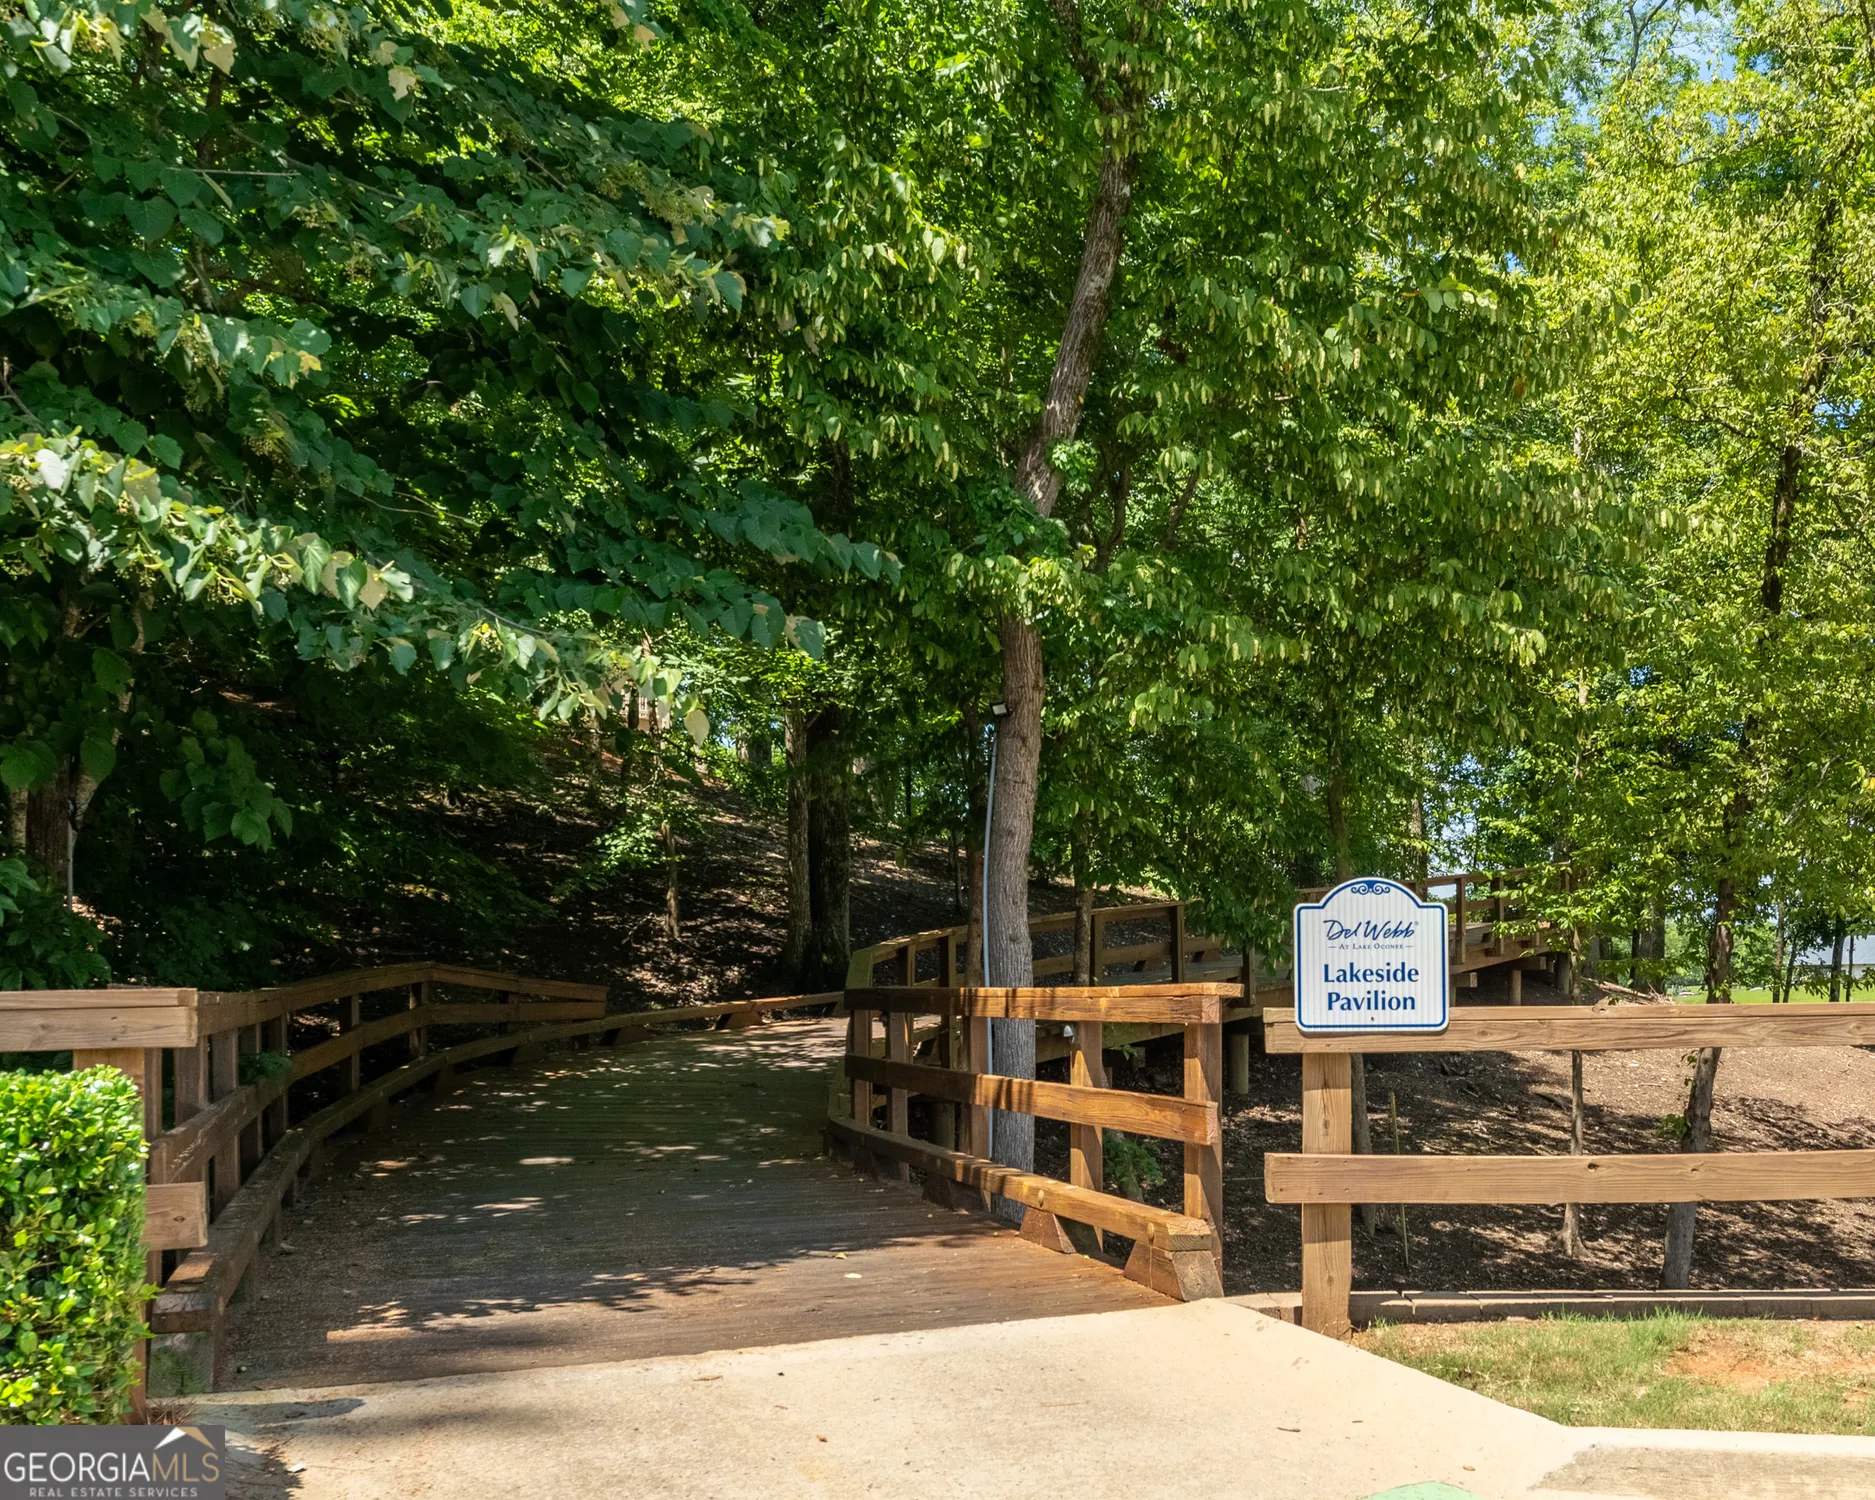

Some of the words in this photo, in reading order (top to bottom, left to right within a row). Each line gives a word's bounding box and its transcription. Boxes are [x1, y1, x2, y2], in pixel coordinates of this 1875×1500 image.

[1323, 919, 1362, 941] Del
[1323, 962, 1420, 983] Lakeside
[1327, 990, 1416, 1011] Pavilion
